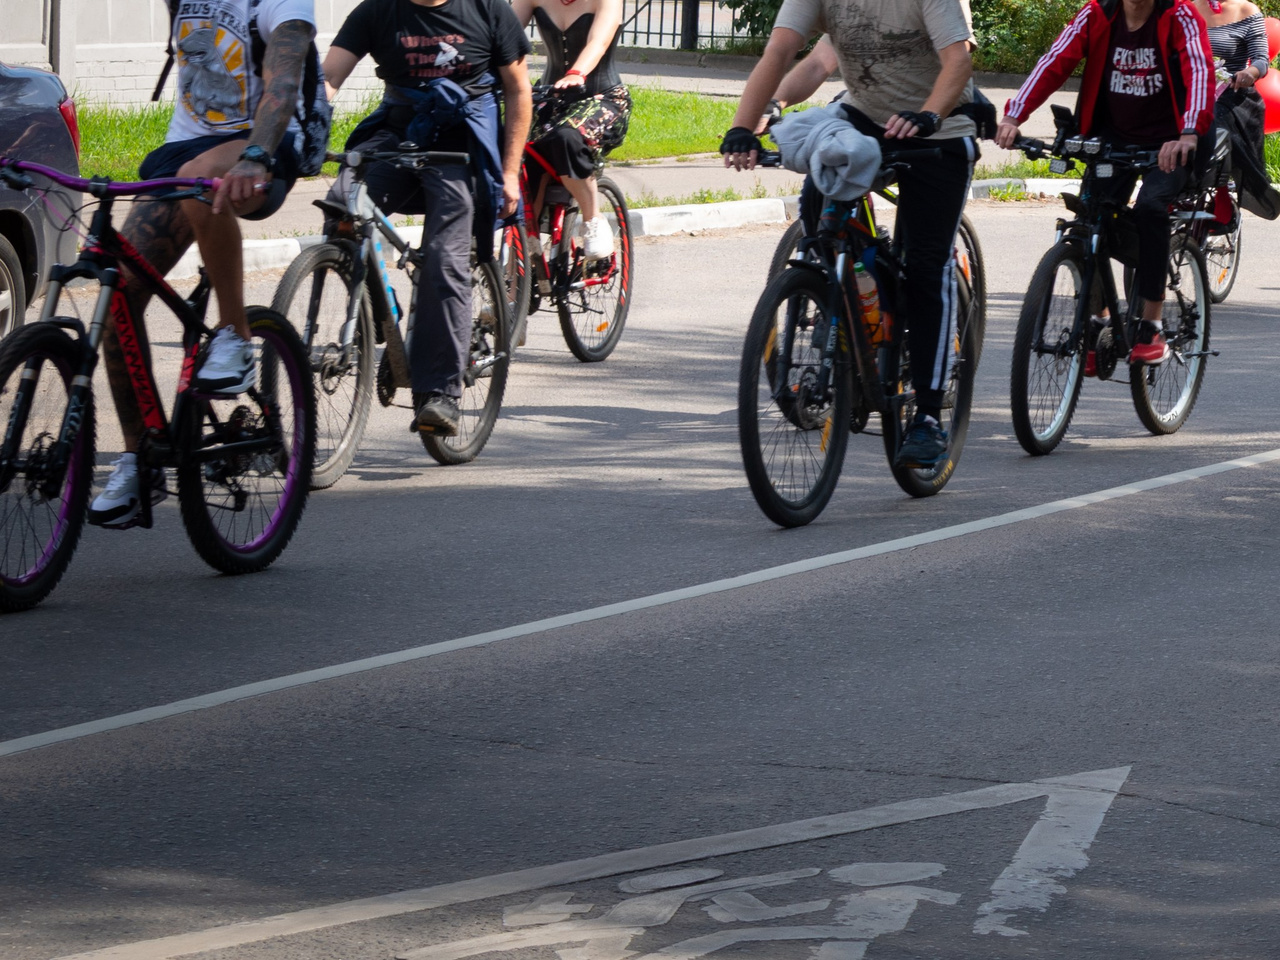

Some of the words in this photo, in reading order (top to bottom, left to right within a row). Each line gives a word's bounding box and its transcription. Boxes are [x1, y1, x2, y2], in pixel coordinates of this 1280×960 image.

[405, 52, 437, 66] The
[1113, 47, 1158, 70] EXCUSE
[1110, 70, 1163, 97] RESULTS
